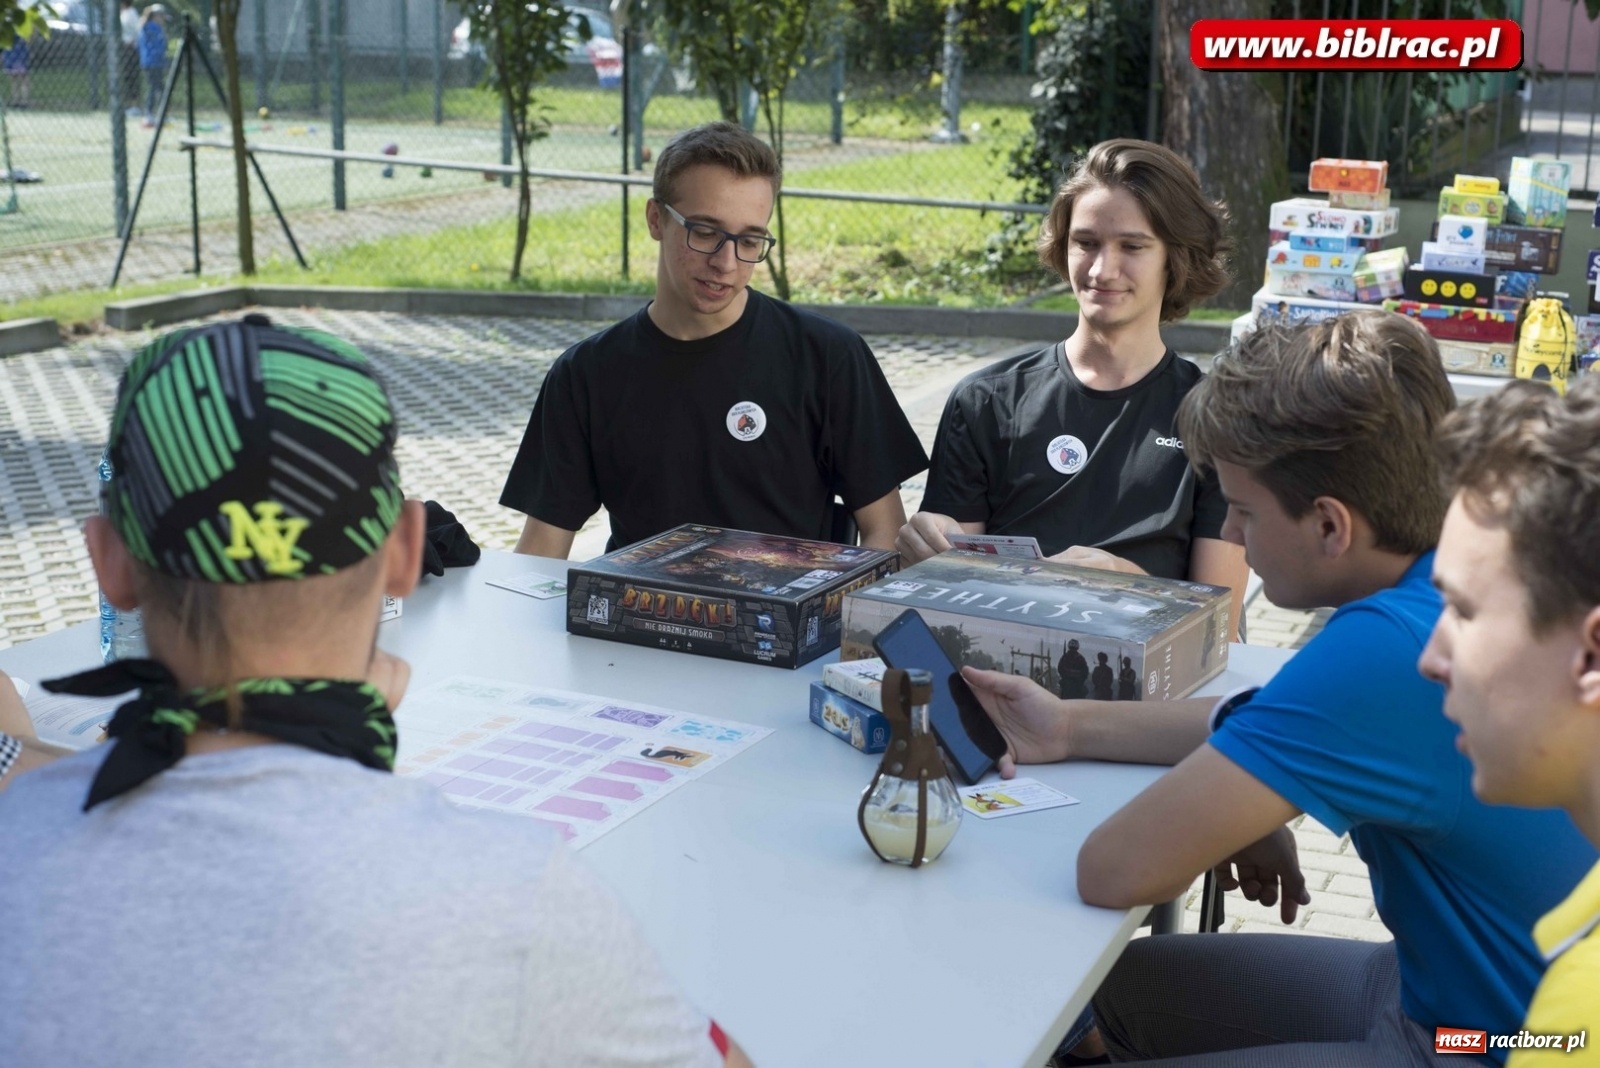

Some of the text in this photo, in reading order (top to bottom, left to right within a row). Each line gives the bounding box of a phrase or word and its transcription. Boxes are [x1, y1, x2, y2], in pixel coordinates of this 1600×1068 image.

[918, 587, 1103, 624] SCYTHE
[645, 622, 656, 631] NIE
[688, 629, 713, 640] SMOKA
